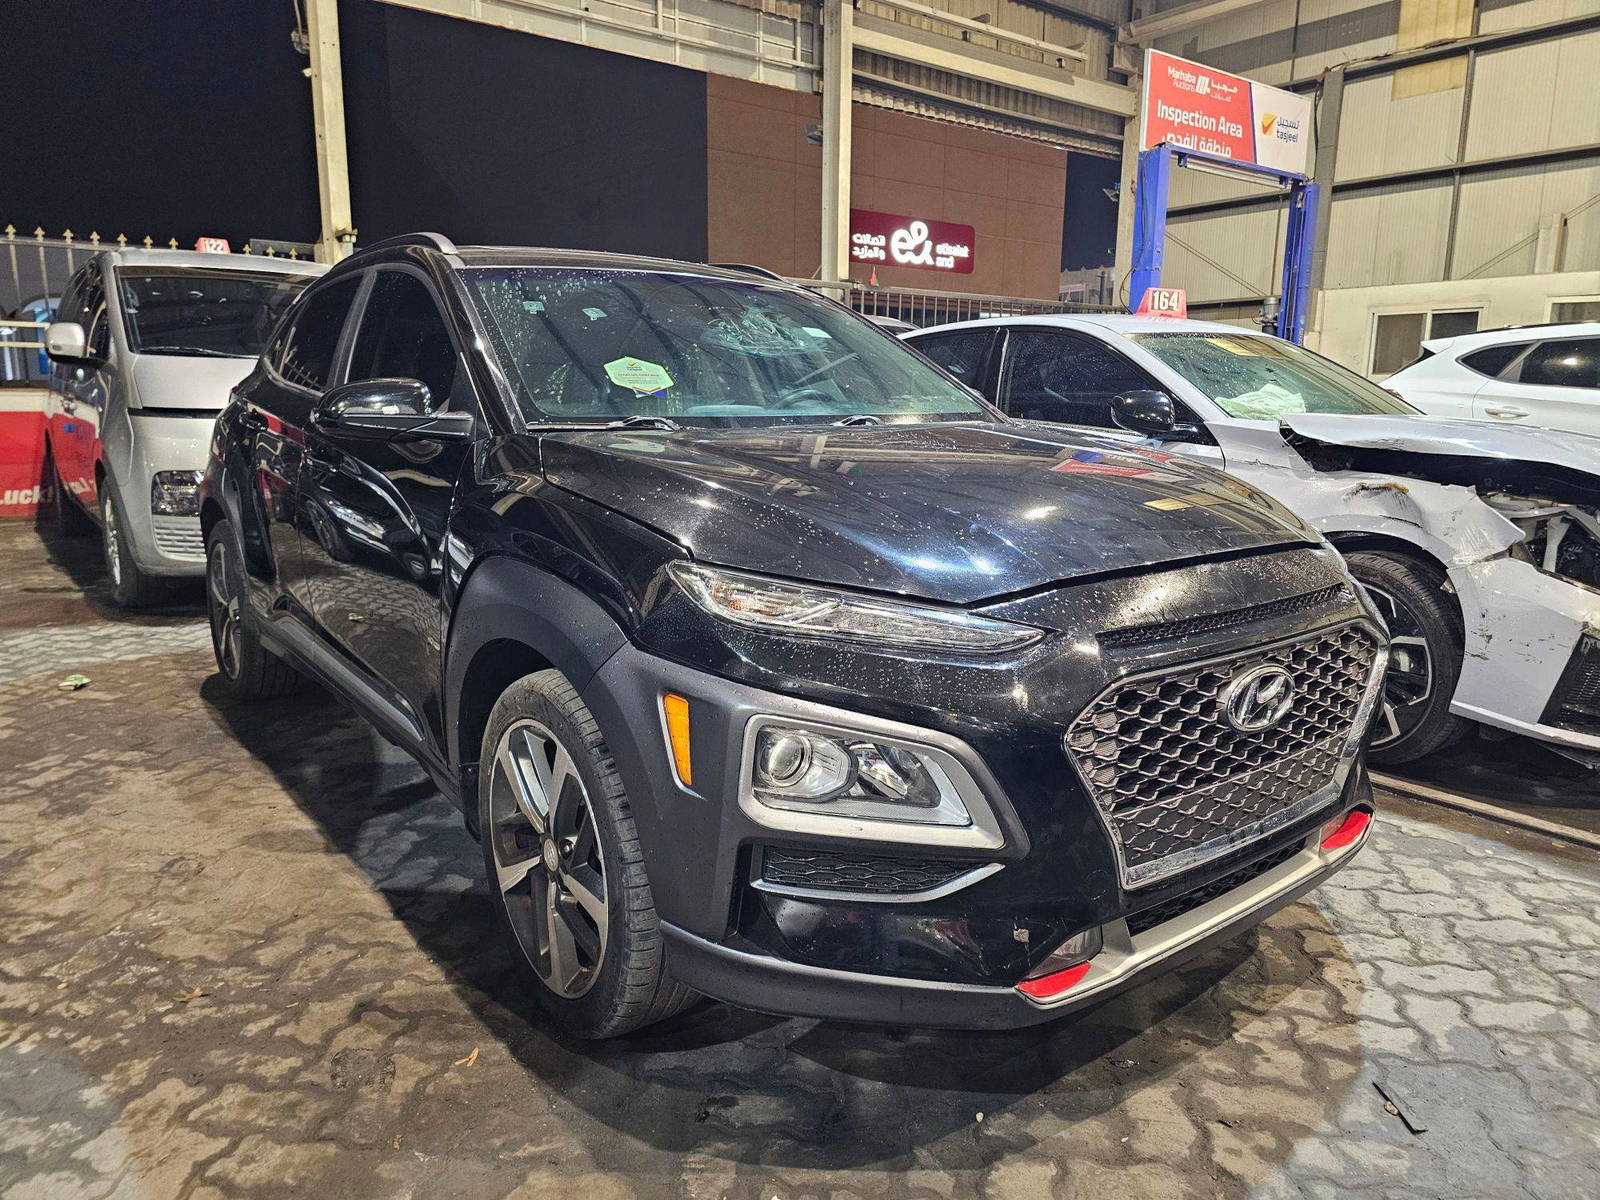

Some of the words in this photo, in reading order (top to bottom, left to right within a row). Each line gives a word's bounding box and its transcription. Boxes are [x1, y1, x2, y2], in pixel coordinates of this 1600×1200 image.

[1167, 65, 1196, 84] Marhaba
[1157, 98, 1217, 132] Inspection
[1218, 115, 1244, 138] Area
[1276, 129, 1299, 143] tasjeel
[936, 243, 969, 257] etisalat
[936, 256, 954, 268] and
[1152, 289, 1180, 311] 164
